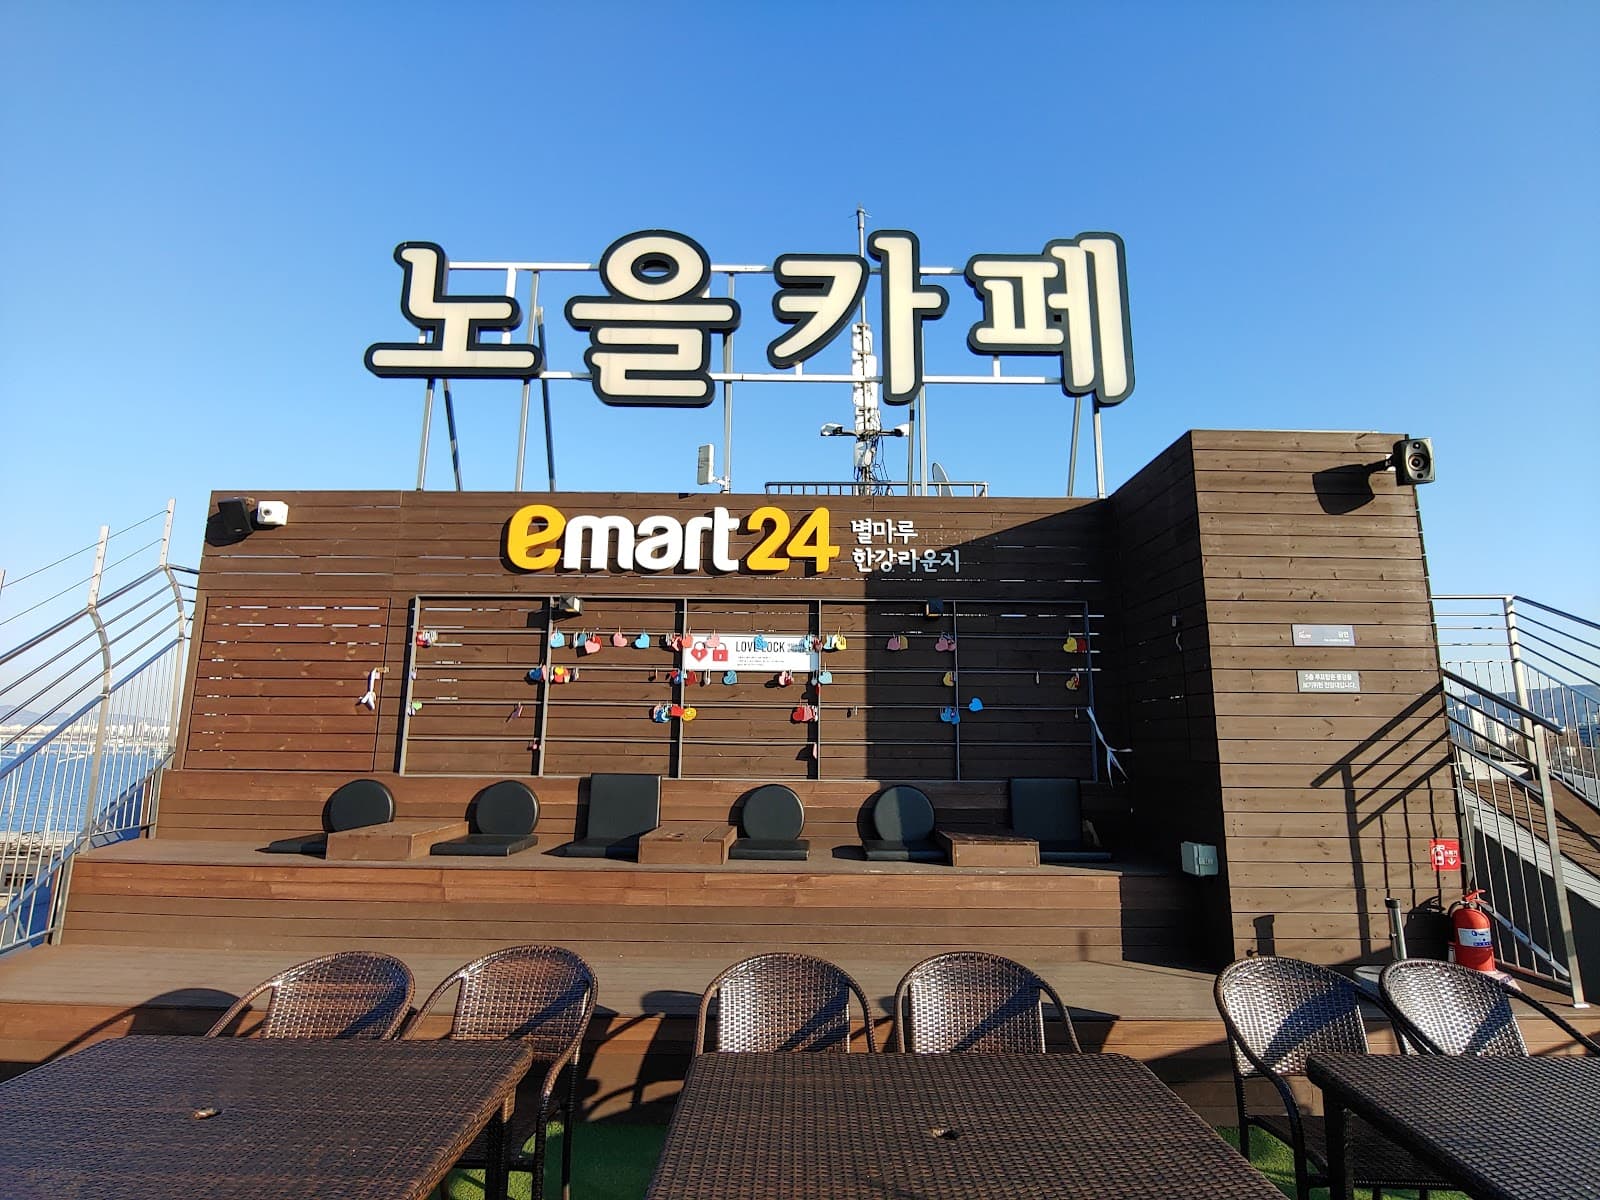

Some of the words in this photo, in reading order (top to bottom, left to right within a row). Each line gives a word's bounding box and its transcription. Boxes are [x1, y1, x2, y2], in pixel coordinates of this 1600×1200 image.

[365, 229, 1135, 407] 노을카페
[507, 504, 840, 573] emart24
[850, 518, 918, 544] 별마루
[852, 547, 960, 573] 한강라운지
